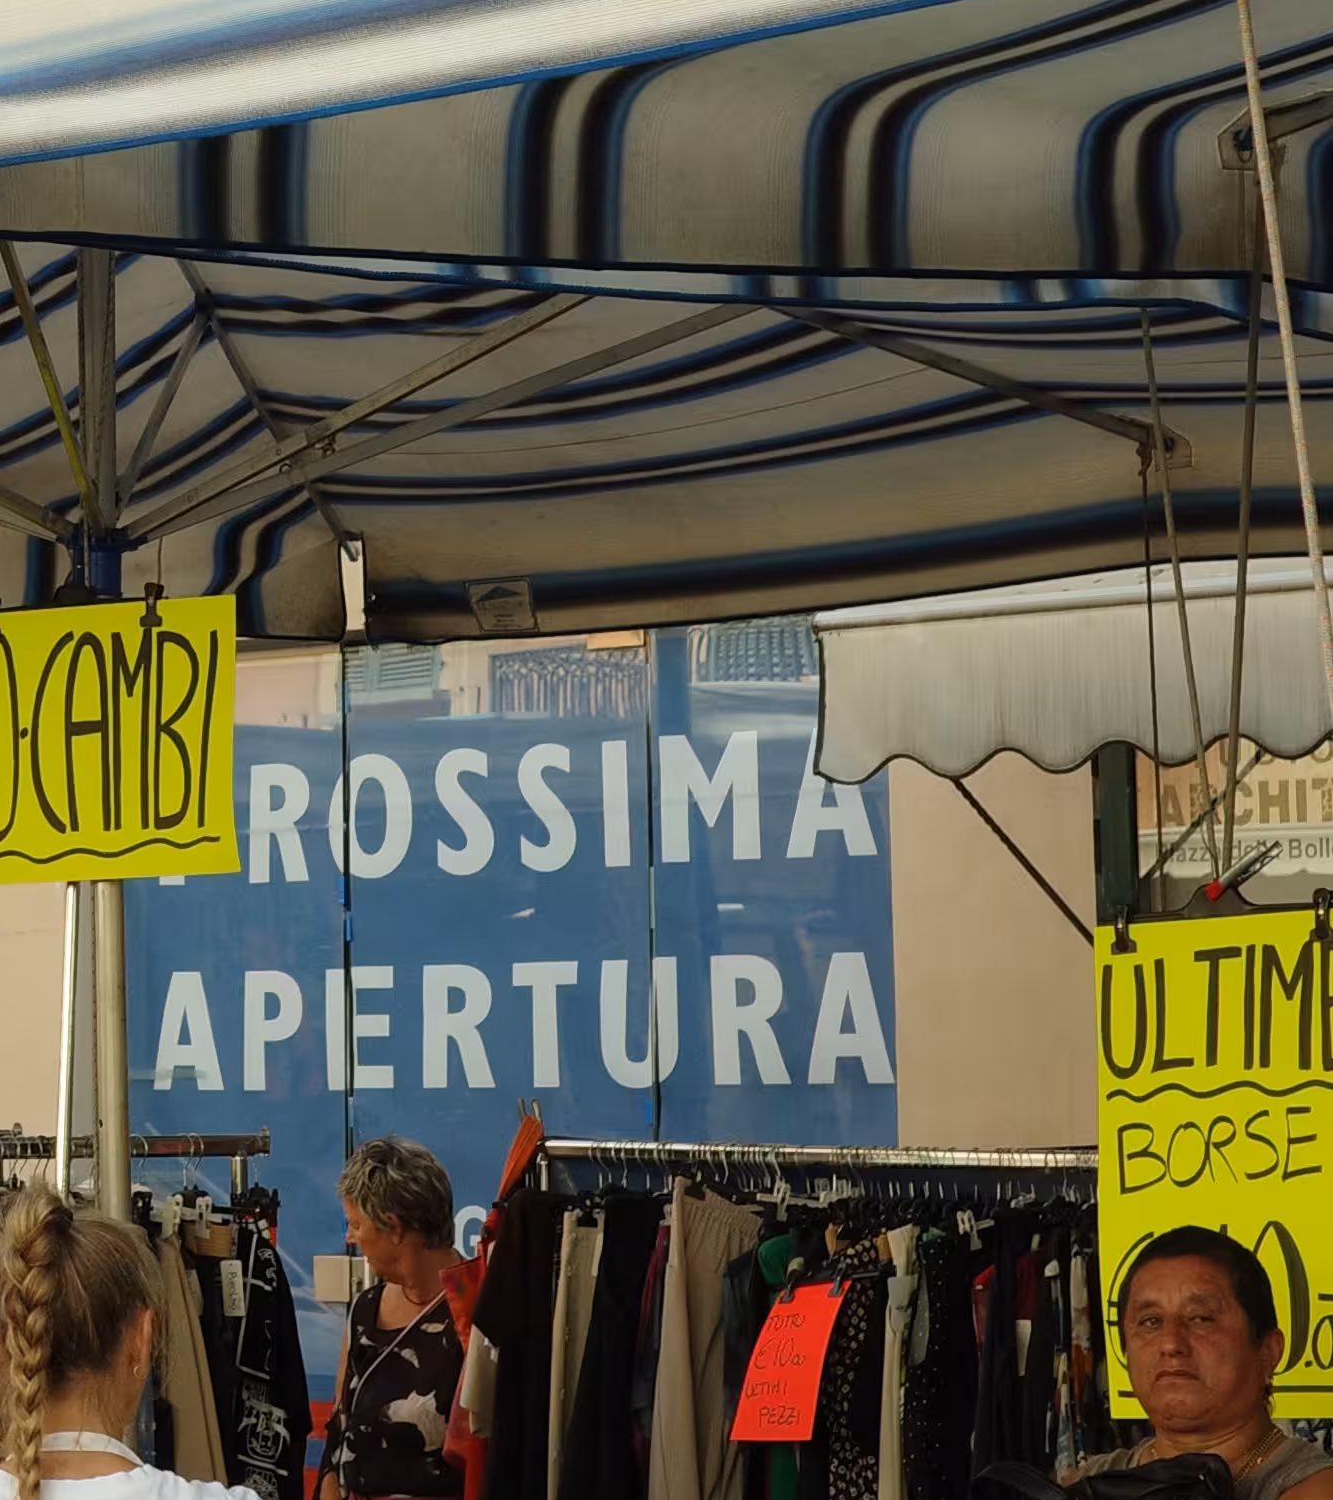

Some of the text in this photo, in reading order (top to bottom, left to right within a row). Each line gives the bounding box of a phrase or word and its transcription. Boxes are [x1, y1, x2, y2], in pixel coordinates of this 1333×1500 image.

[157, 729, 879, 886] ROSSIMA
[1288, 836, 1333, 859] Boll
[153, 951, 896, 1092] APERTURA
[1117, 1106, 1323, 1195] BORSE
[758, 1404, 802, 1429] PEZZI
